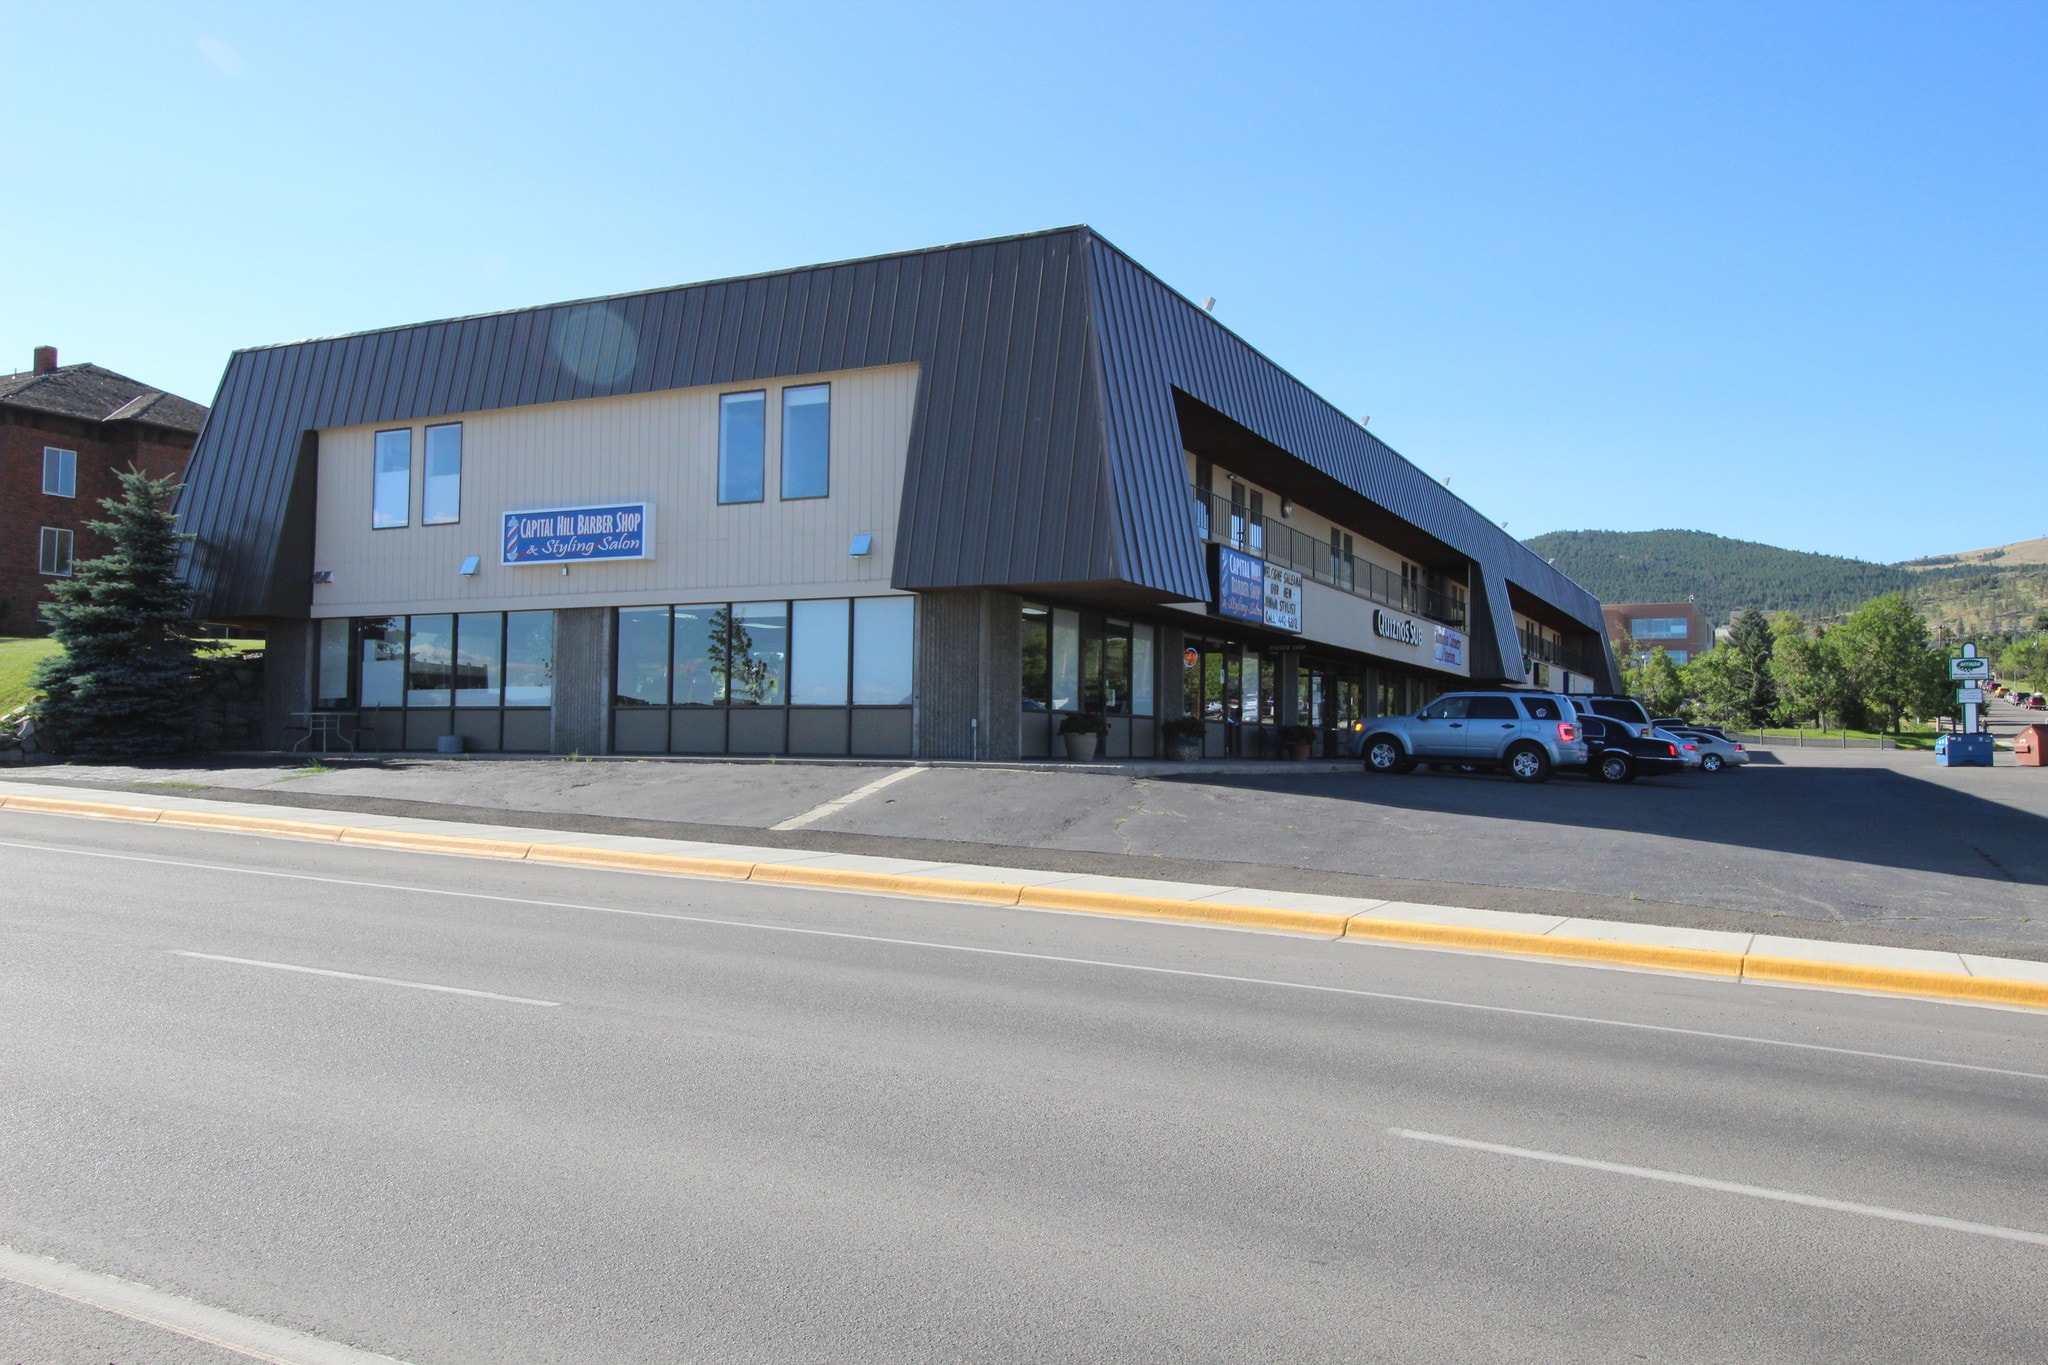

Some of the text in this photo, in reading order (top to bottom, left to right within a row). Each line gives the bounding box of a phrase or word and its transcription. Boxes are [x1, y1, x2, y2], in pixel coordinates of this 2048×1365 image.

[520, 511, 641, 538] CAPITAL HILL BARBER SHOP
[526, 533, 640, 557] & Styling Salon
[1229, 554, 1250, 579] CAPITAL
[1265, 610, 1276, 624] CALL
[1279, 600, 1297, 615] STYLIST
